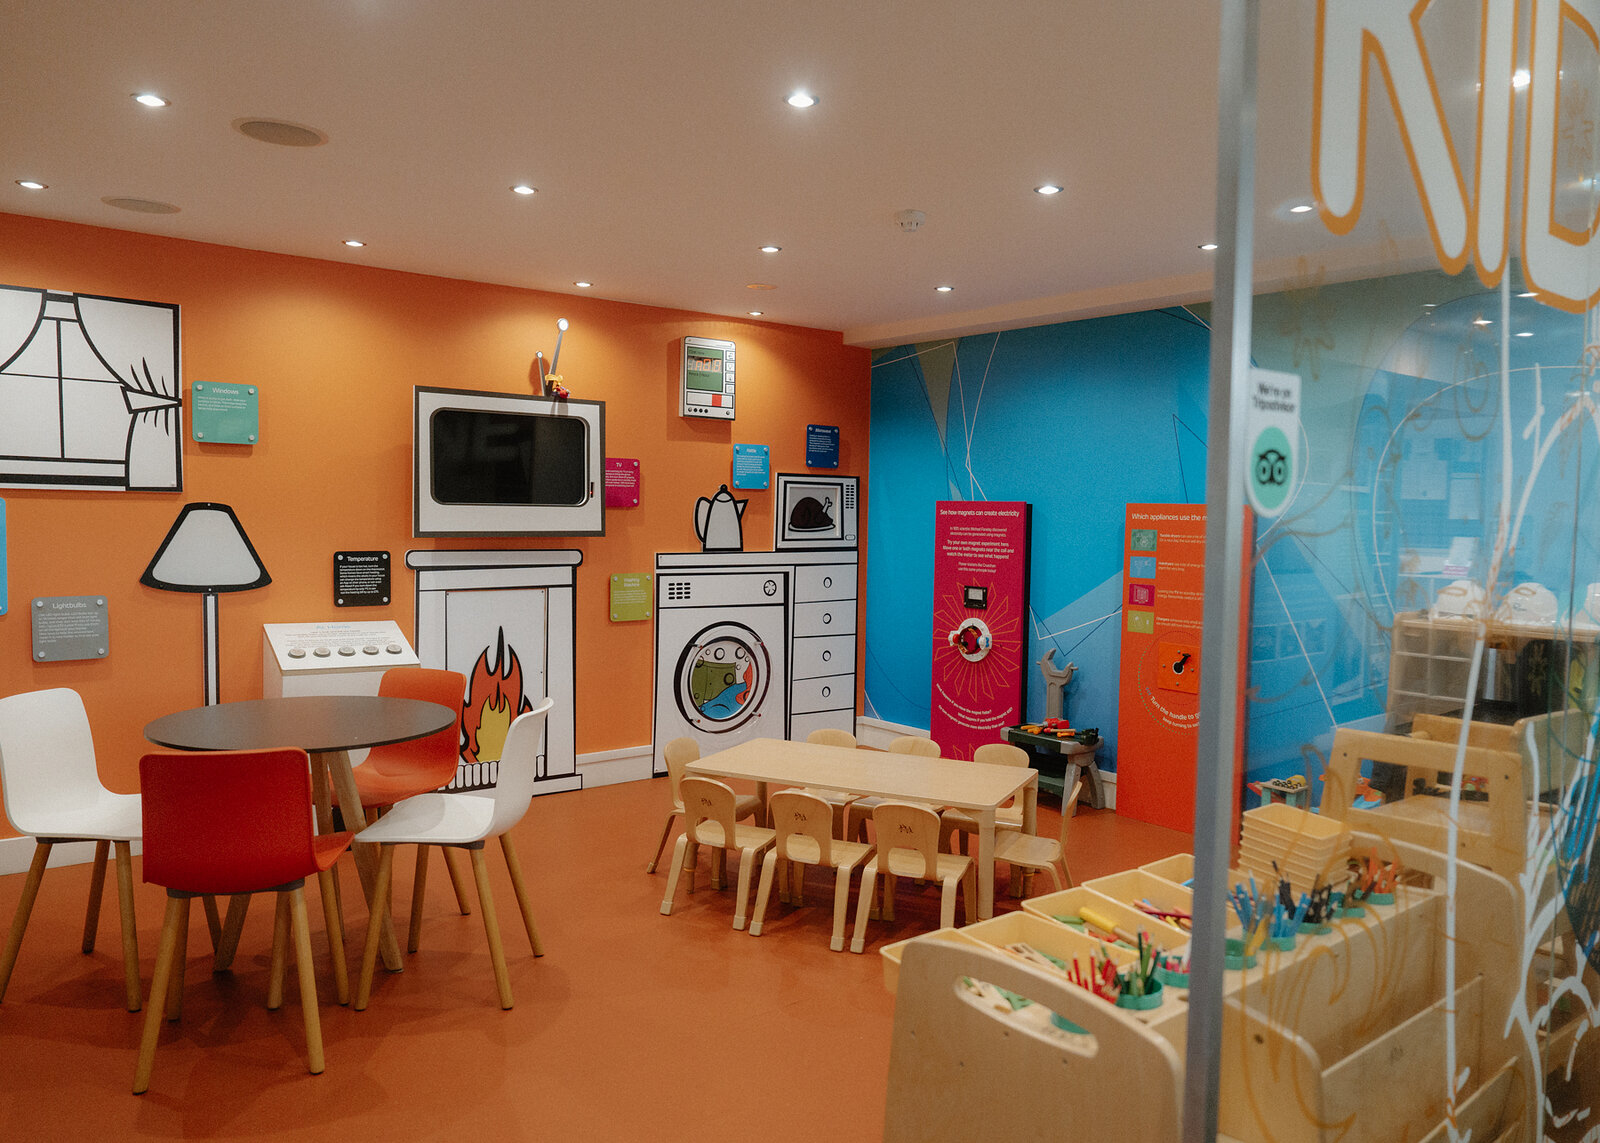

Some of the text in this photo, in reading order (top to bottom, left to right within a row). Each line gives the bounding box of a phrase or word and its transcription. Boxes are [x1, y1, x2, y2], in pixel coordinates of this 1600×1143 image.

[1150, 514, 1178, 522] appliances
[1150, 696, 1160, 708] Turn
[1160, 707, 1169, 715] the
[1169, 712, 1187, 720] handle
